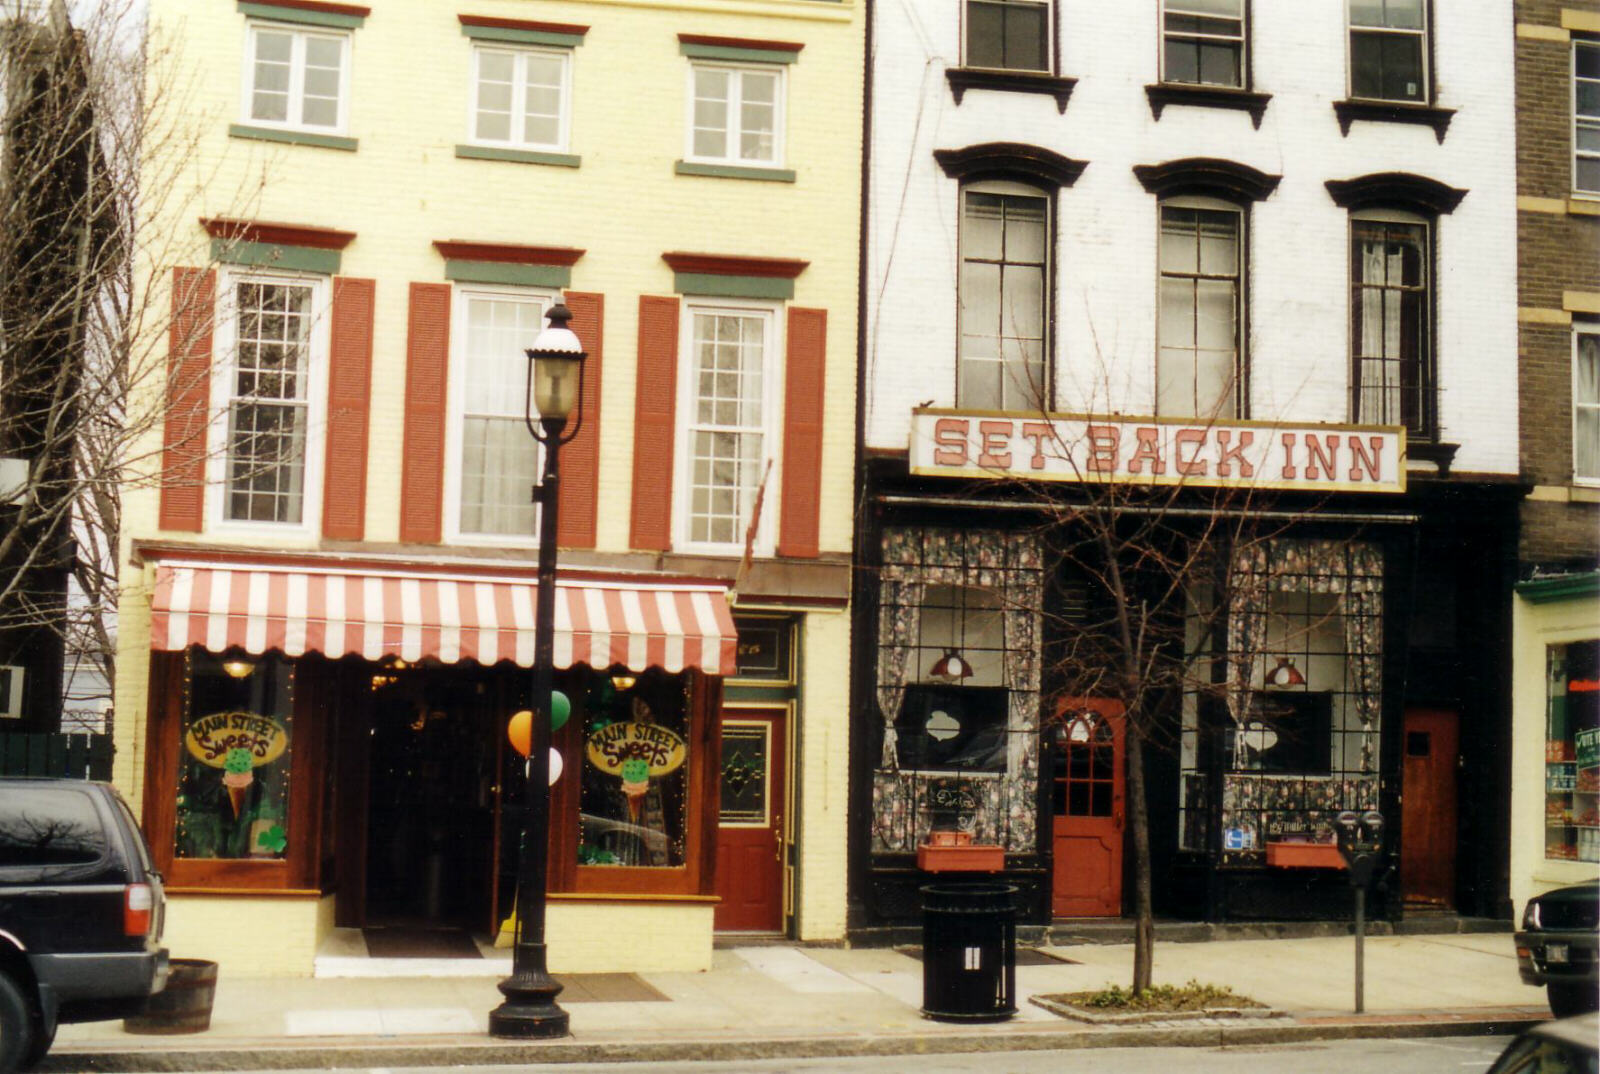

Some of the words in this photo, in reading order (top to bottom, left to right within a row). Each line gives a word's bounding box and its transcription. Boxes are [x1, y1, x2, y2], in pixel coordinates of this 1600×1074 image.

[934, 418, 1055, 470] SET
[1086, 425, 1254, 478] BACK
[1281, 432, 1384, 482] INN
[190, 714, 228, 742] MAIN
[231, 714, 281, 740] STREET
[589, 723, 628, 752] MAIN
[633, 723, 682, 752] STREET
[198, 733, 270, 760] Sweets
[602, 741, 669, 768] Sweets
